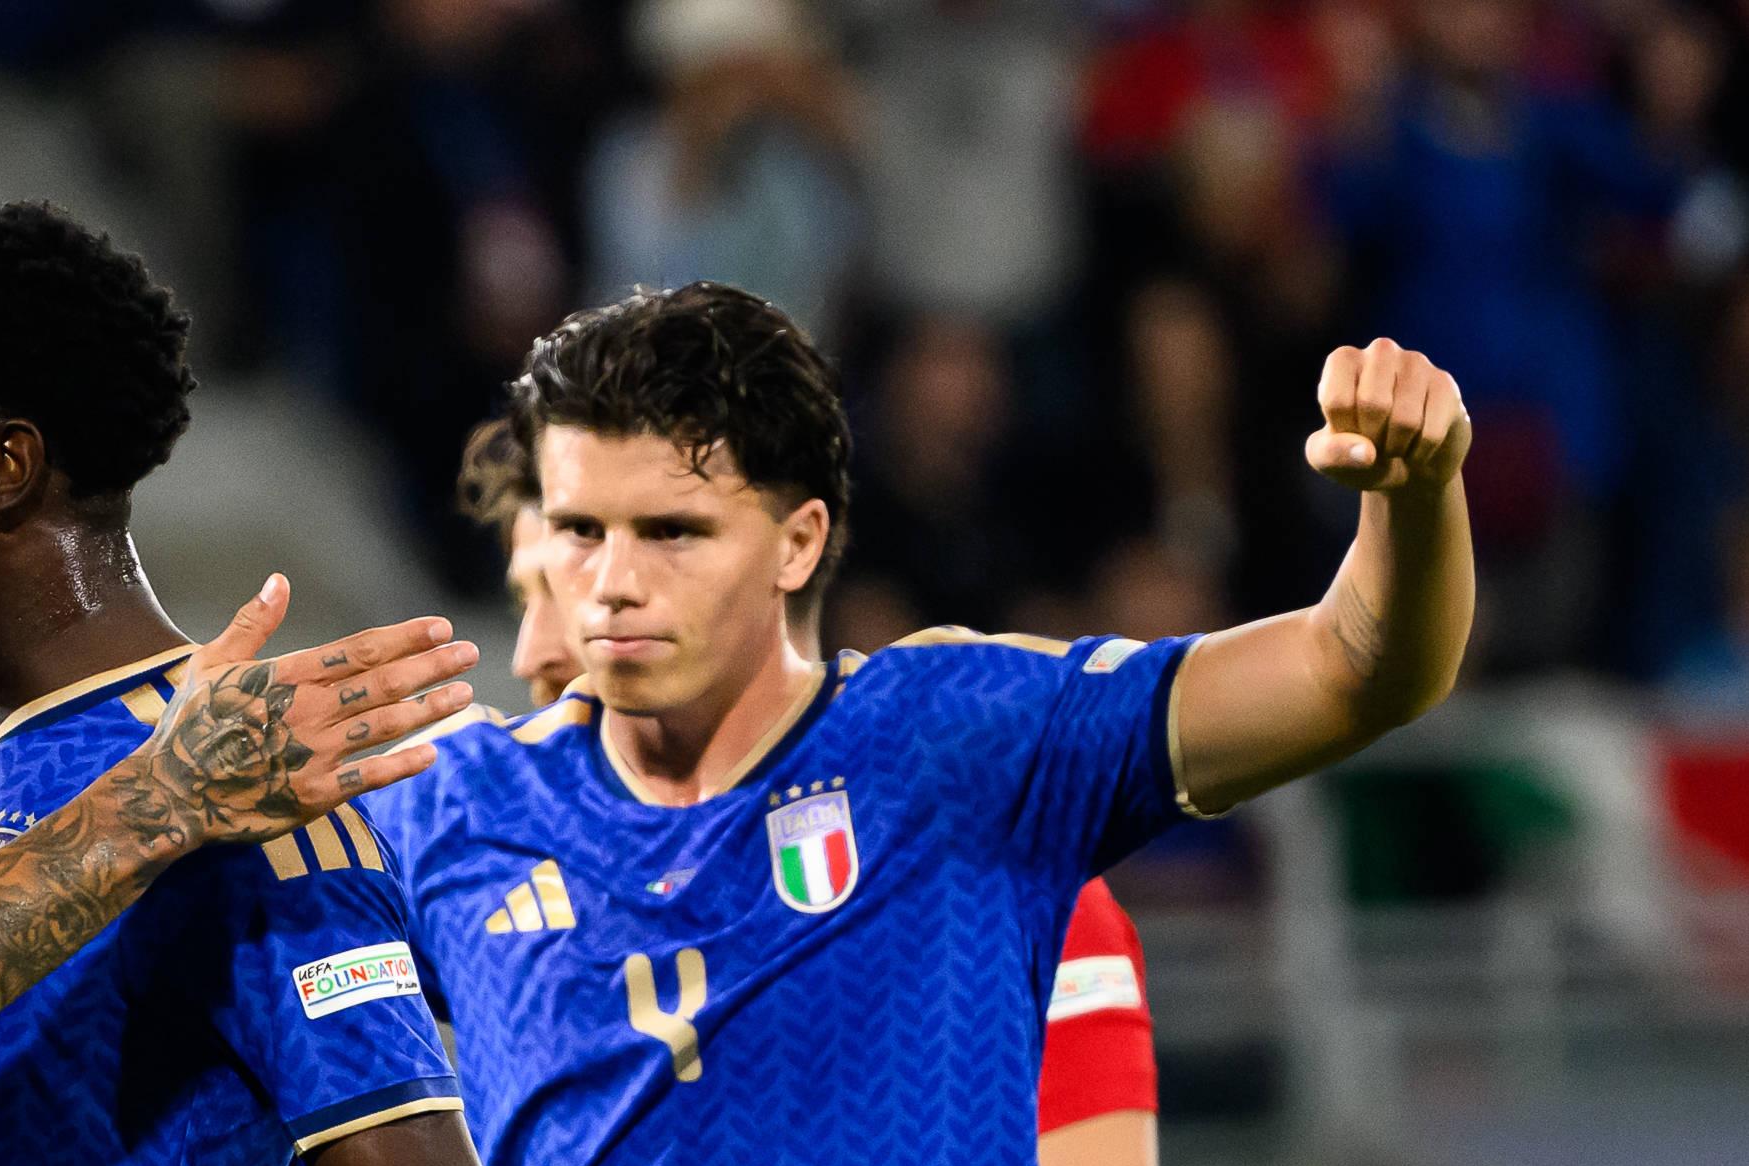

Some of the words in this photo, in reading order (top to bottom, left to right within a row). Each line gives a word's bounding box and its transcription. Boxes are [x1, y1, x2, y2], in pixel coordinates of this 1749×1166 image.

[298, 962, 332, 982] UEFA
[302, 959, 414, 1001] FOUNDATION
[626, 947, 707, 1083] 4
